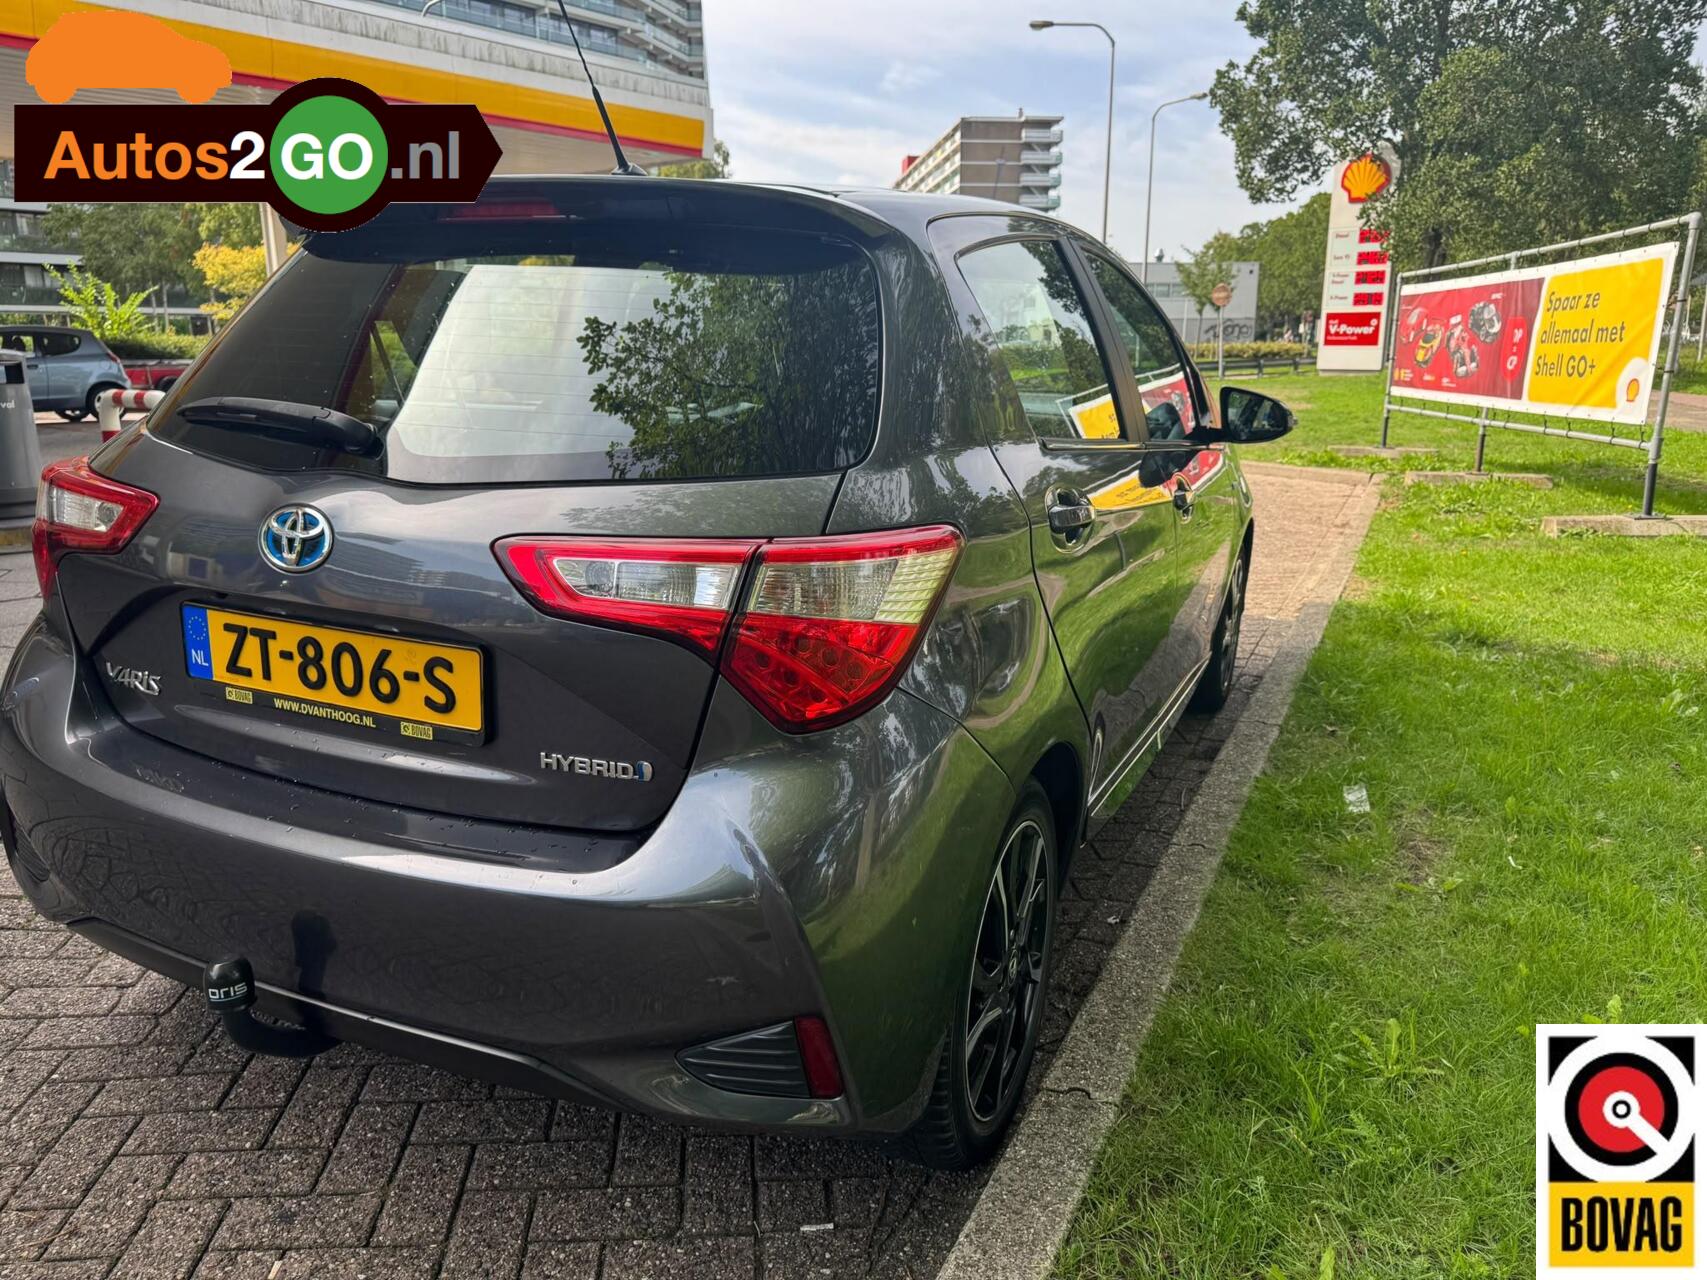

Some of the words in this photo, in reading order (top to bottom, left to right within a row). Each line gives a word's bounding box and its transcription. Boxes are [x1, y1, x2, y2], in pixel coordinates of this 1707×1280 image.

[1547, 291, 1583, 318] Spaar
[1584, 292, 1601, 310] ze
[1328, 324, 1376, 335] V-Power
[1540, 319, 1594, 345] allemaal
[1596, 321, 1626, 343] met
[1535, 353, 1564, 377] Shell
[1566, 354, 1597, 378] GO+
[191, 648, 209, 667] NL
[222, 622, 457, 715] ZT-806-S
[273, 698, 377, 729] WWW.DVANTHOOG.NL
[411, 725, 432, 739] BOVAG
[539, 751, 635, 780] HYBRID
